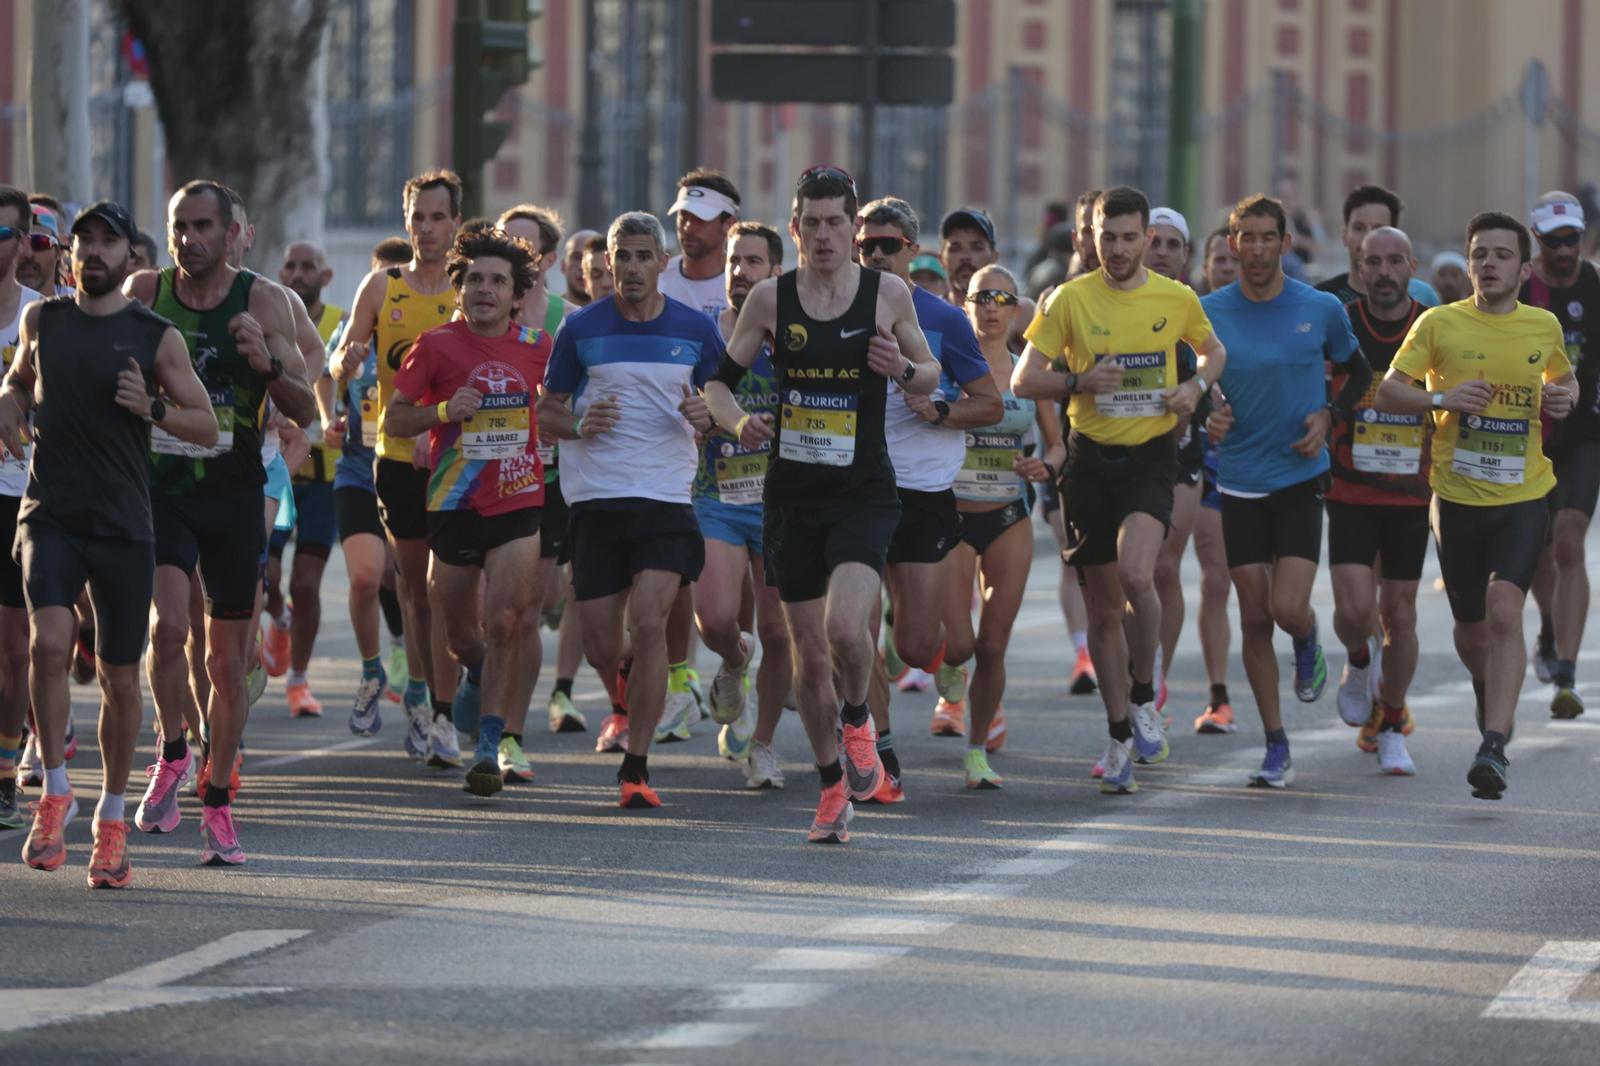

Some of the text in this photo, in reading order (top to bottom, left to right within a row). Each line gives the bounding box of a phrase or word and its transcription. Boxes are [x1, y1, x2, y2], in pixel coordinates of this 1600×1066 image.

[1118, 355, 1159, 367] ZURICH
[787, 368, 860, 379] EAGLE AC
[1122, 377, 1141, 388] 890
[485, 396, 524, 407] ZURICH
[803, 395, 848, 409] ZURICH
[1113, 393, 1152, 402] AURELIEN
[488, 418, 506, 428] 782
[1378, 412, 1417, 424] ZURICH
[806, 418, 826, 430] 735
[1483, 420, 1523, 432] ZURICH
[475, 433, 519, 443] A. ÁLVAREZ
[800, 435, 832, 447] FERGUS
[977, 436, 1015, 448] ZURICH
[1381, 432, 1398, 443] 781
[1481, 441, 1505, 452] 1151
[1375, 448, 1401, 457] NACHO
[977, 456, 1001, 467] 1115
[1480, 456, 1502, 467] BART
[741, 463, 760, 475] 979
[976, 472, 999, 481] ERIKA
[720, 479, 755, 491] ALBERTO
